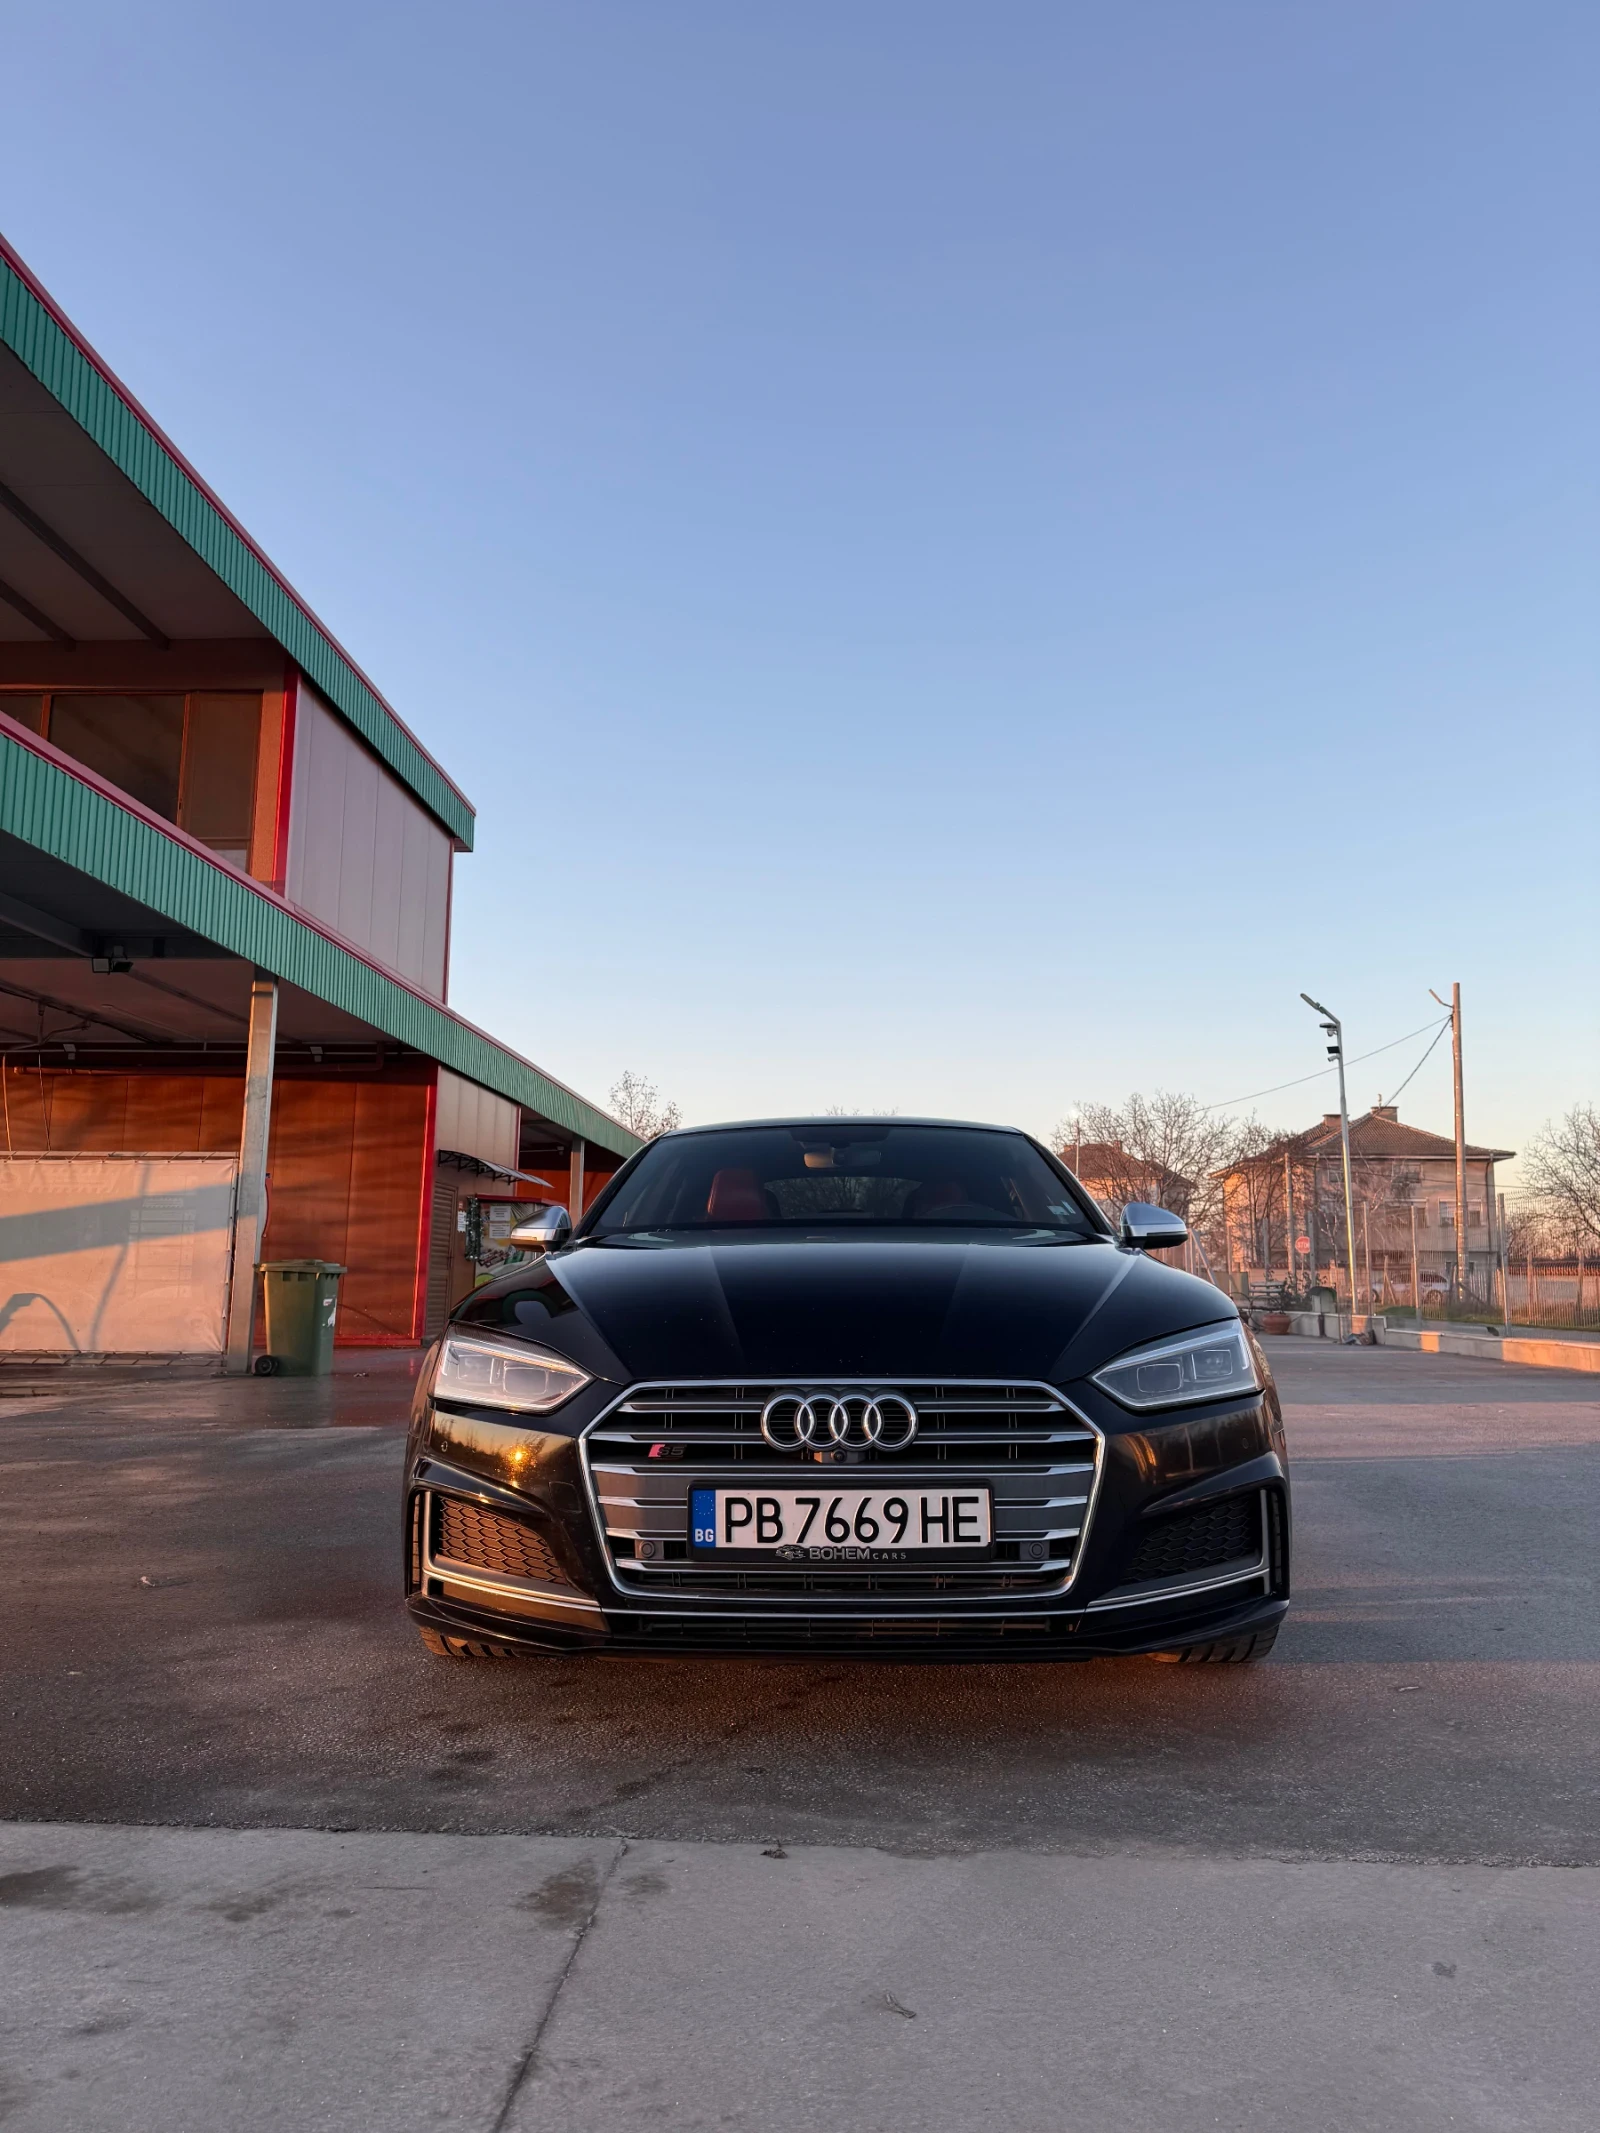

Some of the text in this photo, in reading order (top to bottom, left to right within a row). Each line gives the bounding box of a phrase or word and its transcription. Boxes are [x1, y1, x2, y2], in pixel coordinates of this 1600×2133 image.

[657, 1446, 685, 1457] S5
[694, 1529, 714, 1542] BG
[809, 1547, 907, 1560] BOHEM CARS
